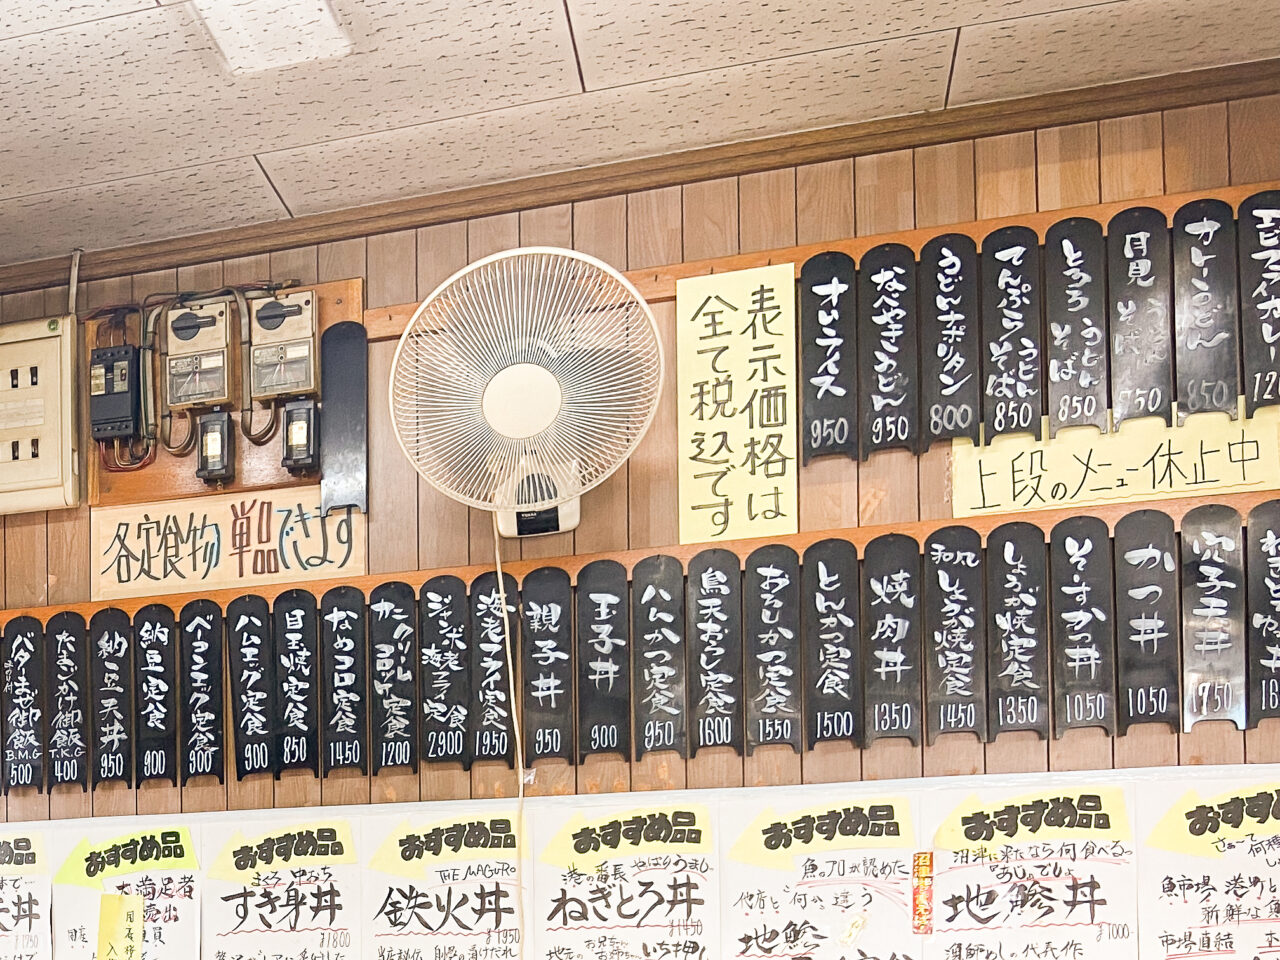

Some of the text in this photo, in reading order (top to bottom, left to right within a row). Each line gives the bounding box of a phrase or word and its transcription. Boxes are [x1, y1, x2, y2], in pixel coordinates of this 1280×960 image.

[1061, 238, 1092, 313] とろろ
[1123, 231, 1156, 289] 月見
[809, 276, 850, 400] オムライス
[870, 266, 908, 412] なべやきうどん
[688, 295, 738, 537] 全て税込です
[739, 285, 794, 520] 表示価格は
[930, 403, 973, 435] 800
[993, 402, 1033, 433] 850
[1058, 394, 1098, 422] 850
[810, 418, 849, 449] 950
[871, 416, 909, 444] 950
[970, 428, 1260, 510] 上段のメニュー休止中
[930, 542, 980, 568] 和風
[995, 540, 1040, 690] しょうが焼定食
[1123, 543, 1176, 654] かつ丼
[587, 593, 626, 693] 玉子丼
[753, 563, 796, 714] おろしかつ定食
[814, 560, 855, 700] とんかつ定食
[870, 569, 915, 683] 焼肉丼
[933, 569, 975, 697] しょうが焼定食
[279, 608, 312, 732] 目玉焼定食
[475, 587, 516, 731] 海老フライ定食
[525, 601, 570, 709] 親子丼
[640, 584, 680, 715] ハムかつ定食
[49, 629, 86, 748] たまごかけ御飯
[140, 621, 170, 731] 納豆定食
[234, 614, 270, 736] ハムエッグ定食
[874, 702, 911, 733] 1350
[939, 702, 975, 731] 1450
[998, 695, 1038, 727] 1350
[1065, 692, 1105, 723] 1050
[1127, 686, 1168, 717] 1050
[428, 730, 463, 757] 2900
[474, 730, 507, 756] 1950
[535, 728, 561, 753] 950
[590, 724, 617, 750] 900
[643, 720, 674, 751] 950
[699, 716, 731, 746] 1600
[758, 718, 792, 743] 1550
[816, 710, 853, 739] 1500
[54, 760, 78, 782] 400
[100, 753, 124, 778] 950
[143, 750, 166, 777] 900
[188, 750, 213, 774] 900
[244, 743, 269, 770] 900
[283, 736, 307, 763] 850
[329, 740, 360, 766] 1450
[381, 741, 410, 766] 1200
[10, 761, 33, 786] 500
[571, 811, 702, 854] おすすめ品
[762, 804, 901, 850] おすすめ品
[961, 794, 1111, 842] おすすめ品
[85, 831, 184, 877] おすすめ品
[232, 828, 344, 871] おすすめ品
[398, 818, 516, 862] おすすめ品
[220, 882, 344, 932] すき身丼
[372, 881, 516, 932] 鉄火丼
[546, 876, 705, 928] ねぎとろ丼
